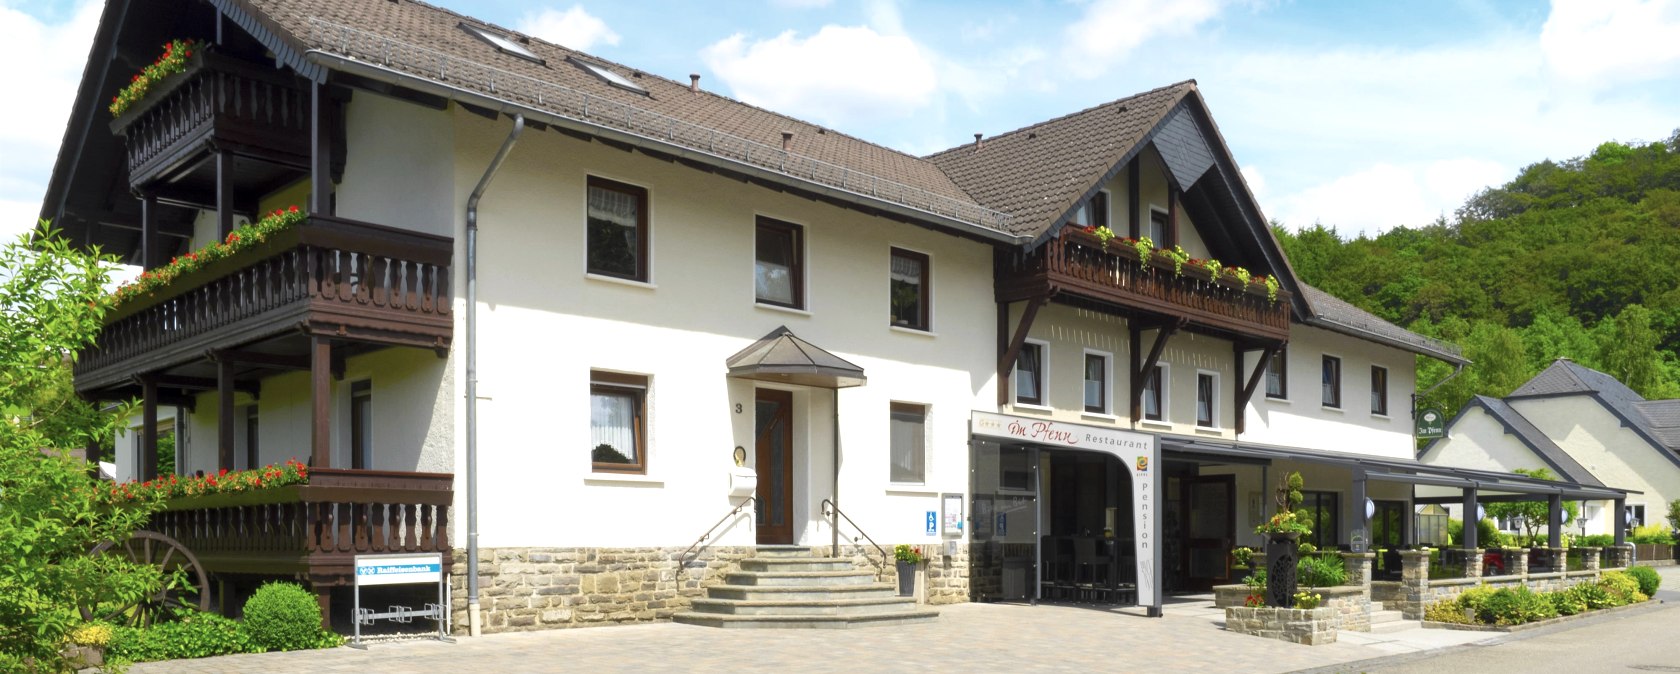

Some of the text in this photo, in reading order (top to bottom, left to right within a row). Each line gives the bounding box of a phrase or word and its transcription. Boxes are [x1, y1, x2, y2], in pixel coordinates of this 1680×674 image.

[735, 403, 743, 414] 3
[1031, 421, 1078, 444] Pfenn
[1085, 433, 1148, 450] Restaurant
[376, 565, 431, 575] Raiffeisenbank
